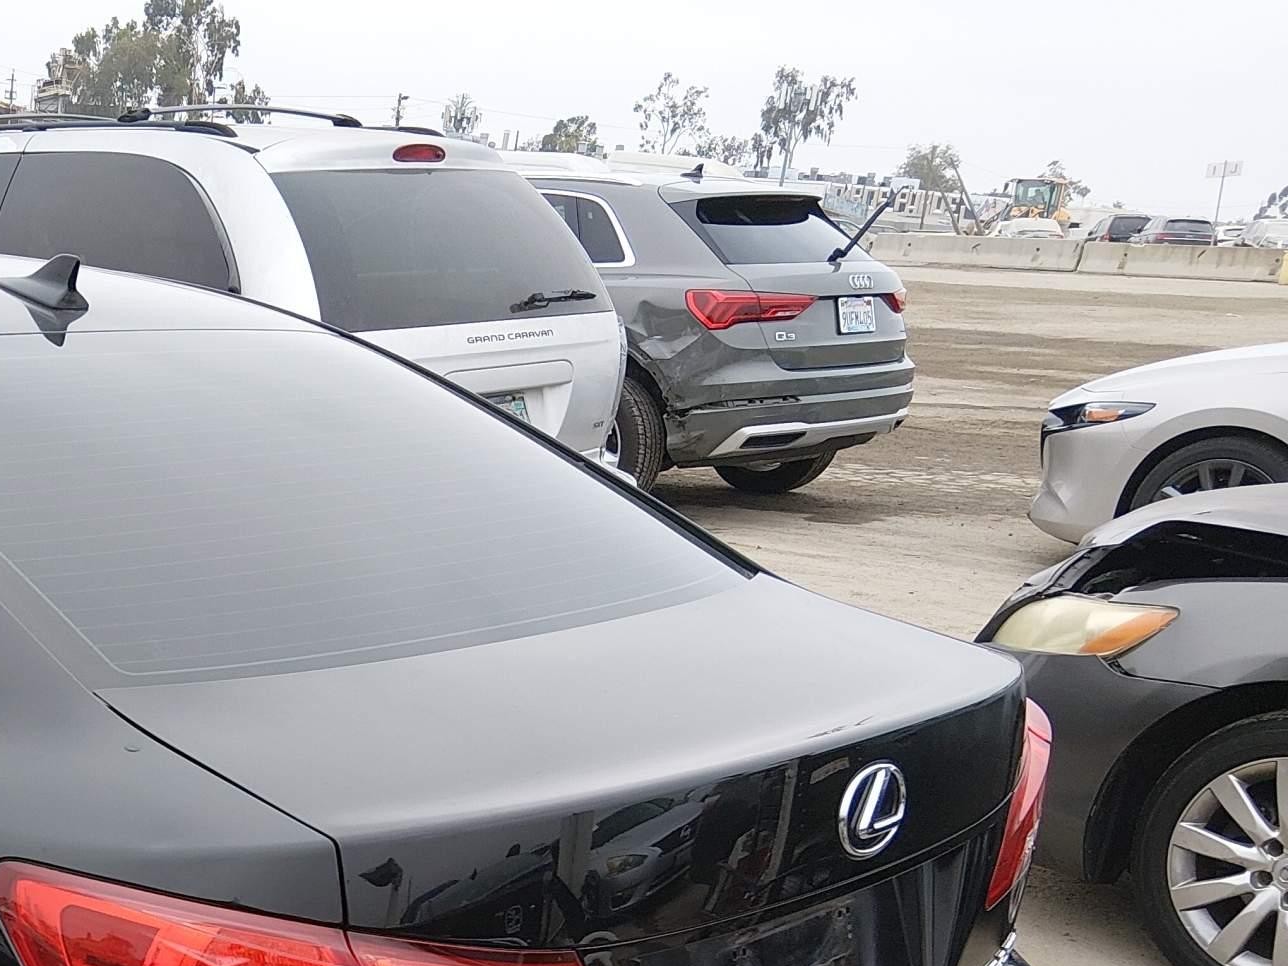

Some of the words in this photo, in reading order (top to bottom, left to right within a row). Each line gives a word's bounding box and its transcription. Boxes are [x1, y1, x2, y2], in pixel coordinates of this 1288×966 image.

[467, 333, 505, 344] GRAND
[507, 328, 554, 341] CARAVAN
[775, 331, 796, 341] Q3
